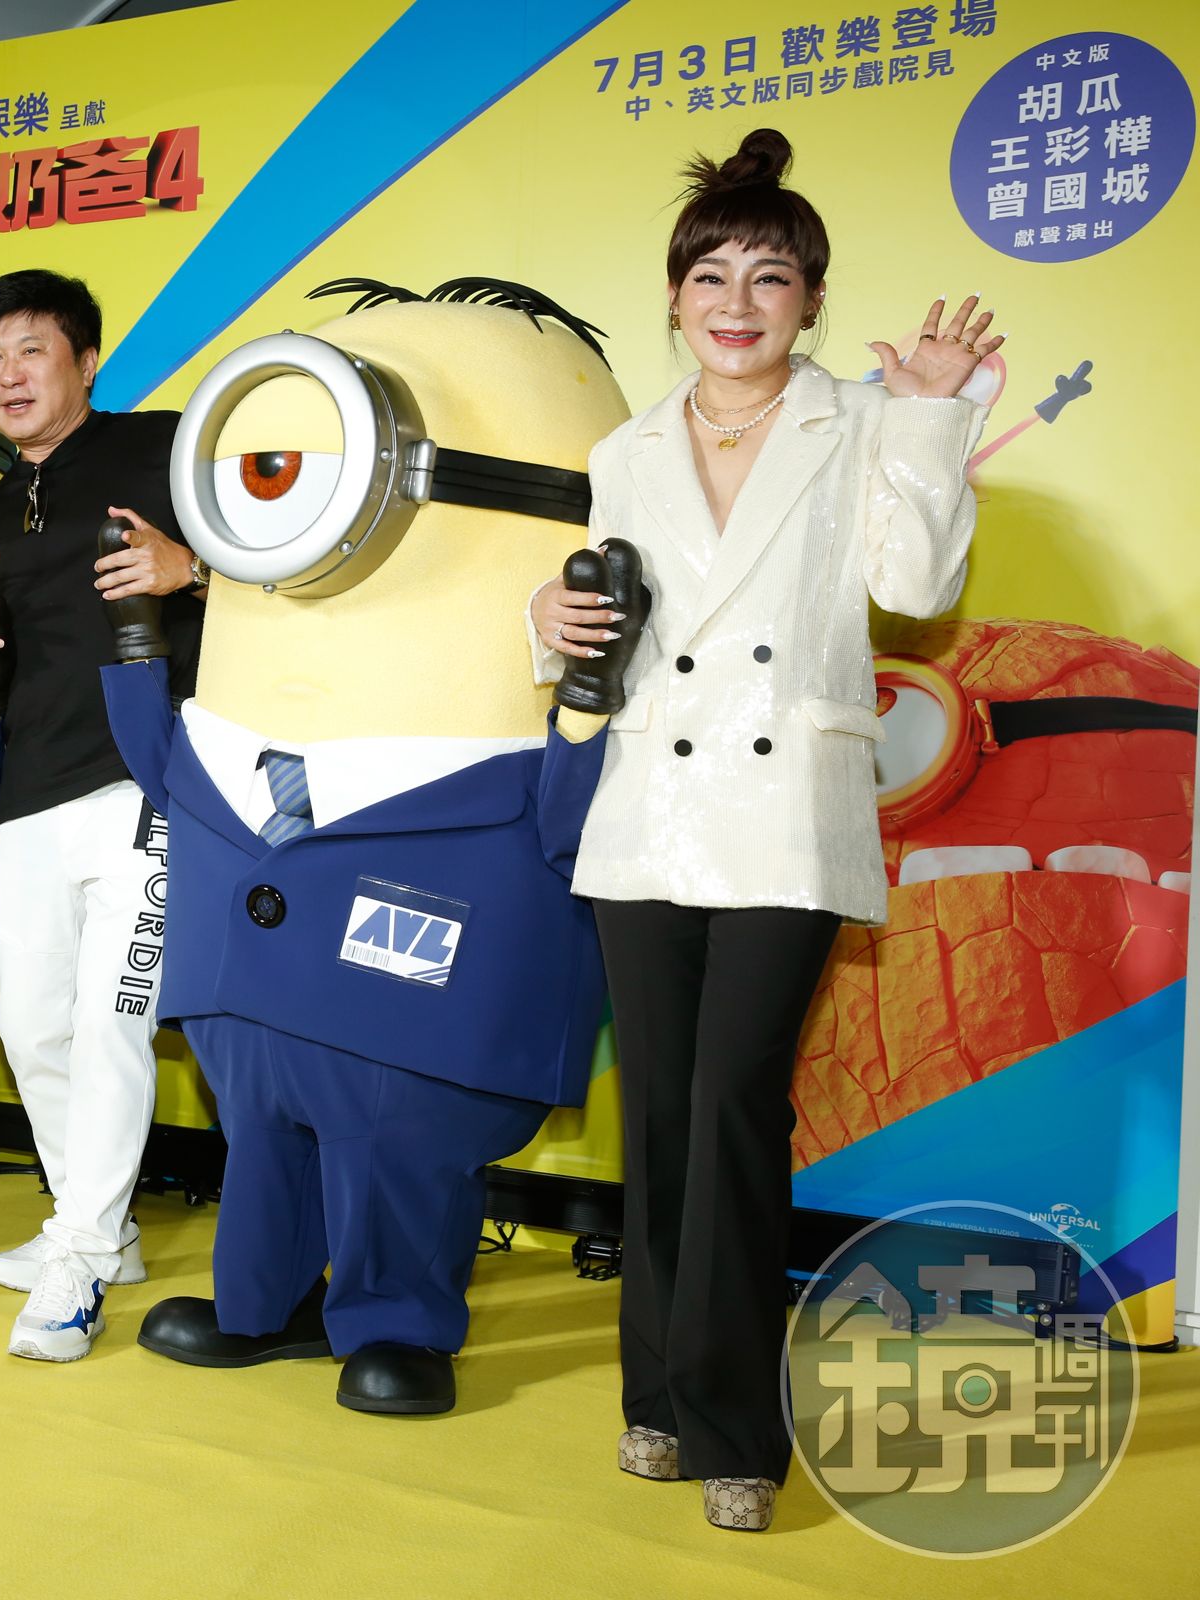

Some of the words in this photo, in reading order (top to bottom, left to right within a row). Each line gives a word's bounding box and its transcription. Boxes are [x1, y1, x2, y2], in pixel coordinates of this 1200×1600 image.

[593, 36, 757, 93] 7月3日
[780, 0, 998, 68] 歡樂登場
[1036, 43, 1110, 71] 中文版
[624, 48, 955, 122] 中、英文版同步戲院見
[1018, 73, 1122, 124] 胡瓜
[59, 100, 106, 130] 呈獻
[987, 115, 1152, 174] 王彩樺
[987, 163, 1150, 221] 曾國城
[1013, 219, 1114, 249] 獻聲演出
[348, 904, 453, 965] AVL
[1029, 1212, 1101, 1231] UNIVERSAL
